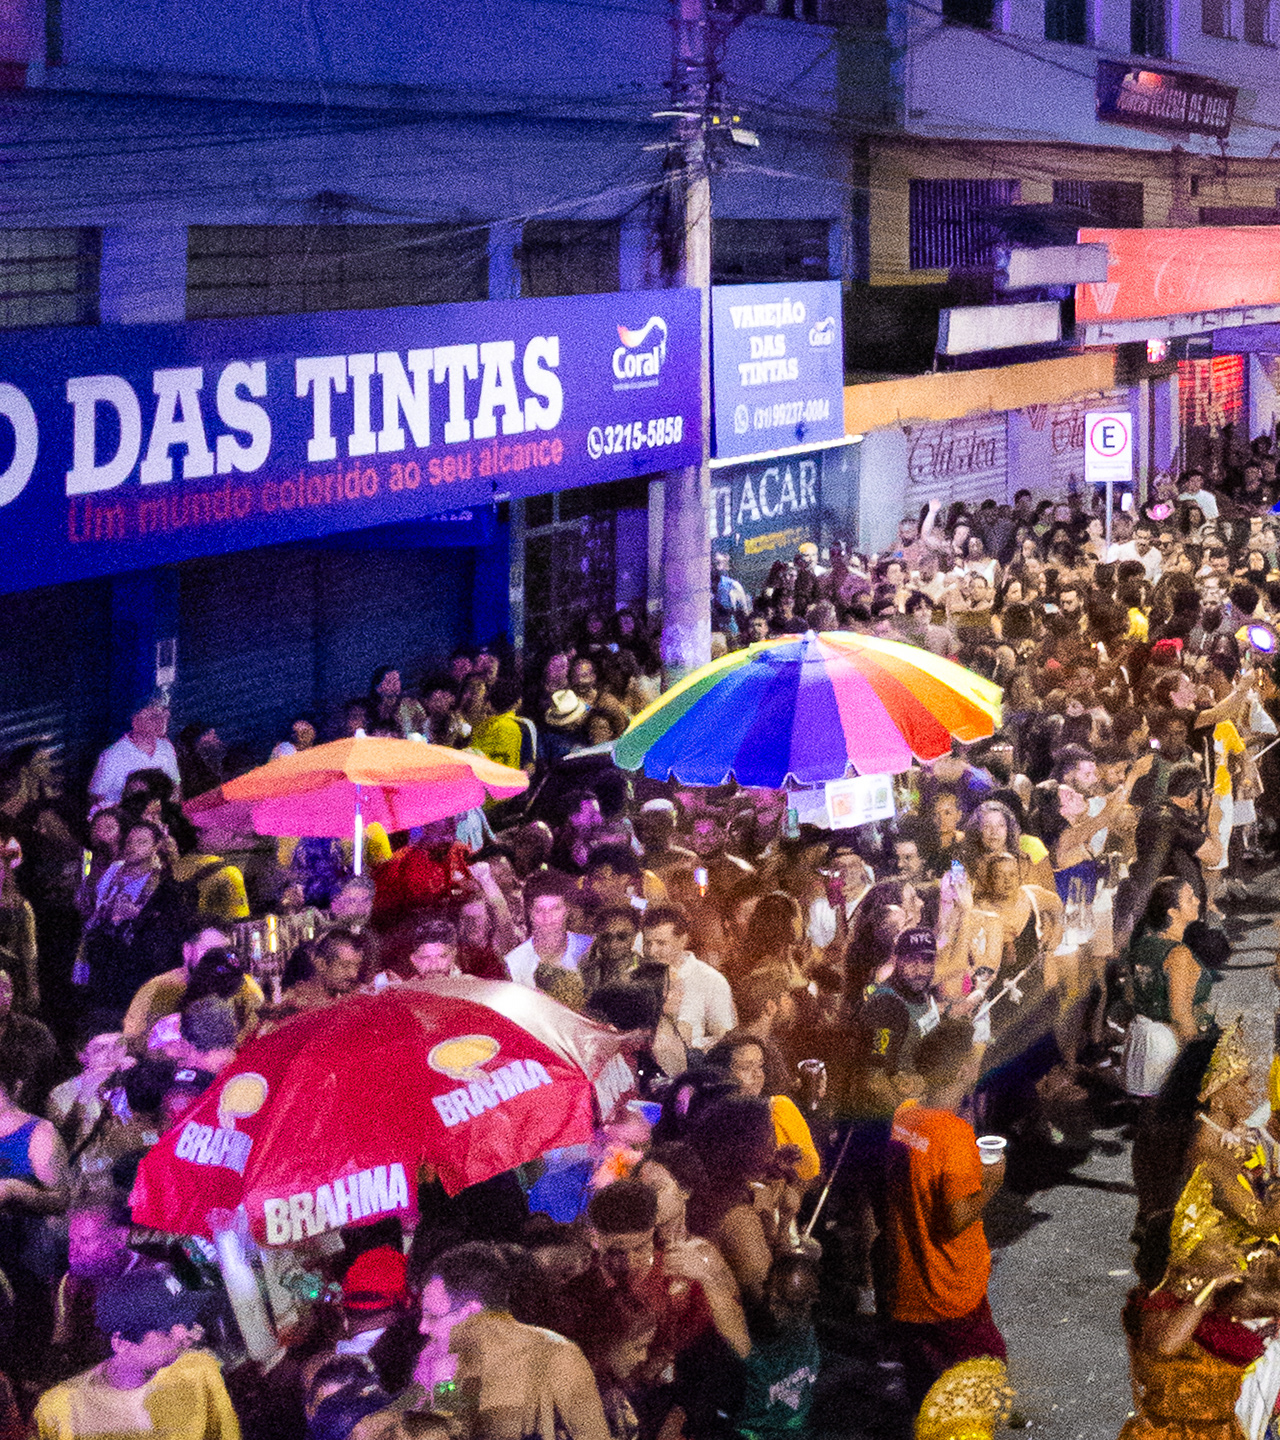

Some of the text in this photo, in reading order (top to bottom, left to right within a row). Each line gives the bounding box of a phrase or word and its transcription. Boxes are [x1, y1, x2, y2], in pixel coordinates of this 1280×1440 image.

[730, 297, 806, 329] VAREJÃO
[612, 346, 660, 380] Coral
[750, 334, 786, 359] DAS
[738, 357, 799, 386] TINTAS
[65, 360, 272, 497] DAS
[295, 336, 564, 463] TINTAS
[604, 415, 684, 456] 3215-5858
[1102, 425, 1116, 449] E
[67, 438, 564, 544] Um mundo colorido ao seu alcance
[431, 1058, 553, 1128] BRAHMA
[263, 1162, 410, 1246] BRAHMA
